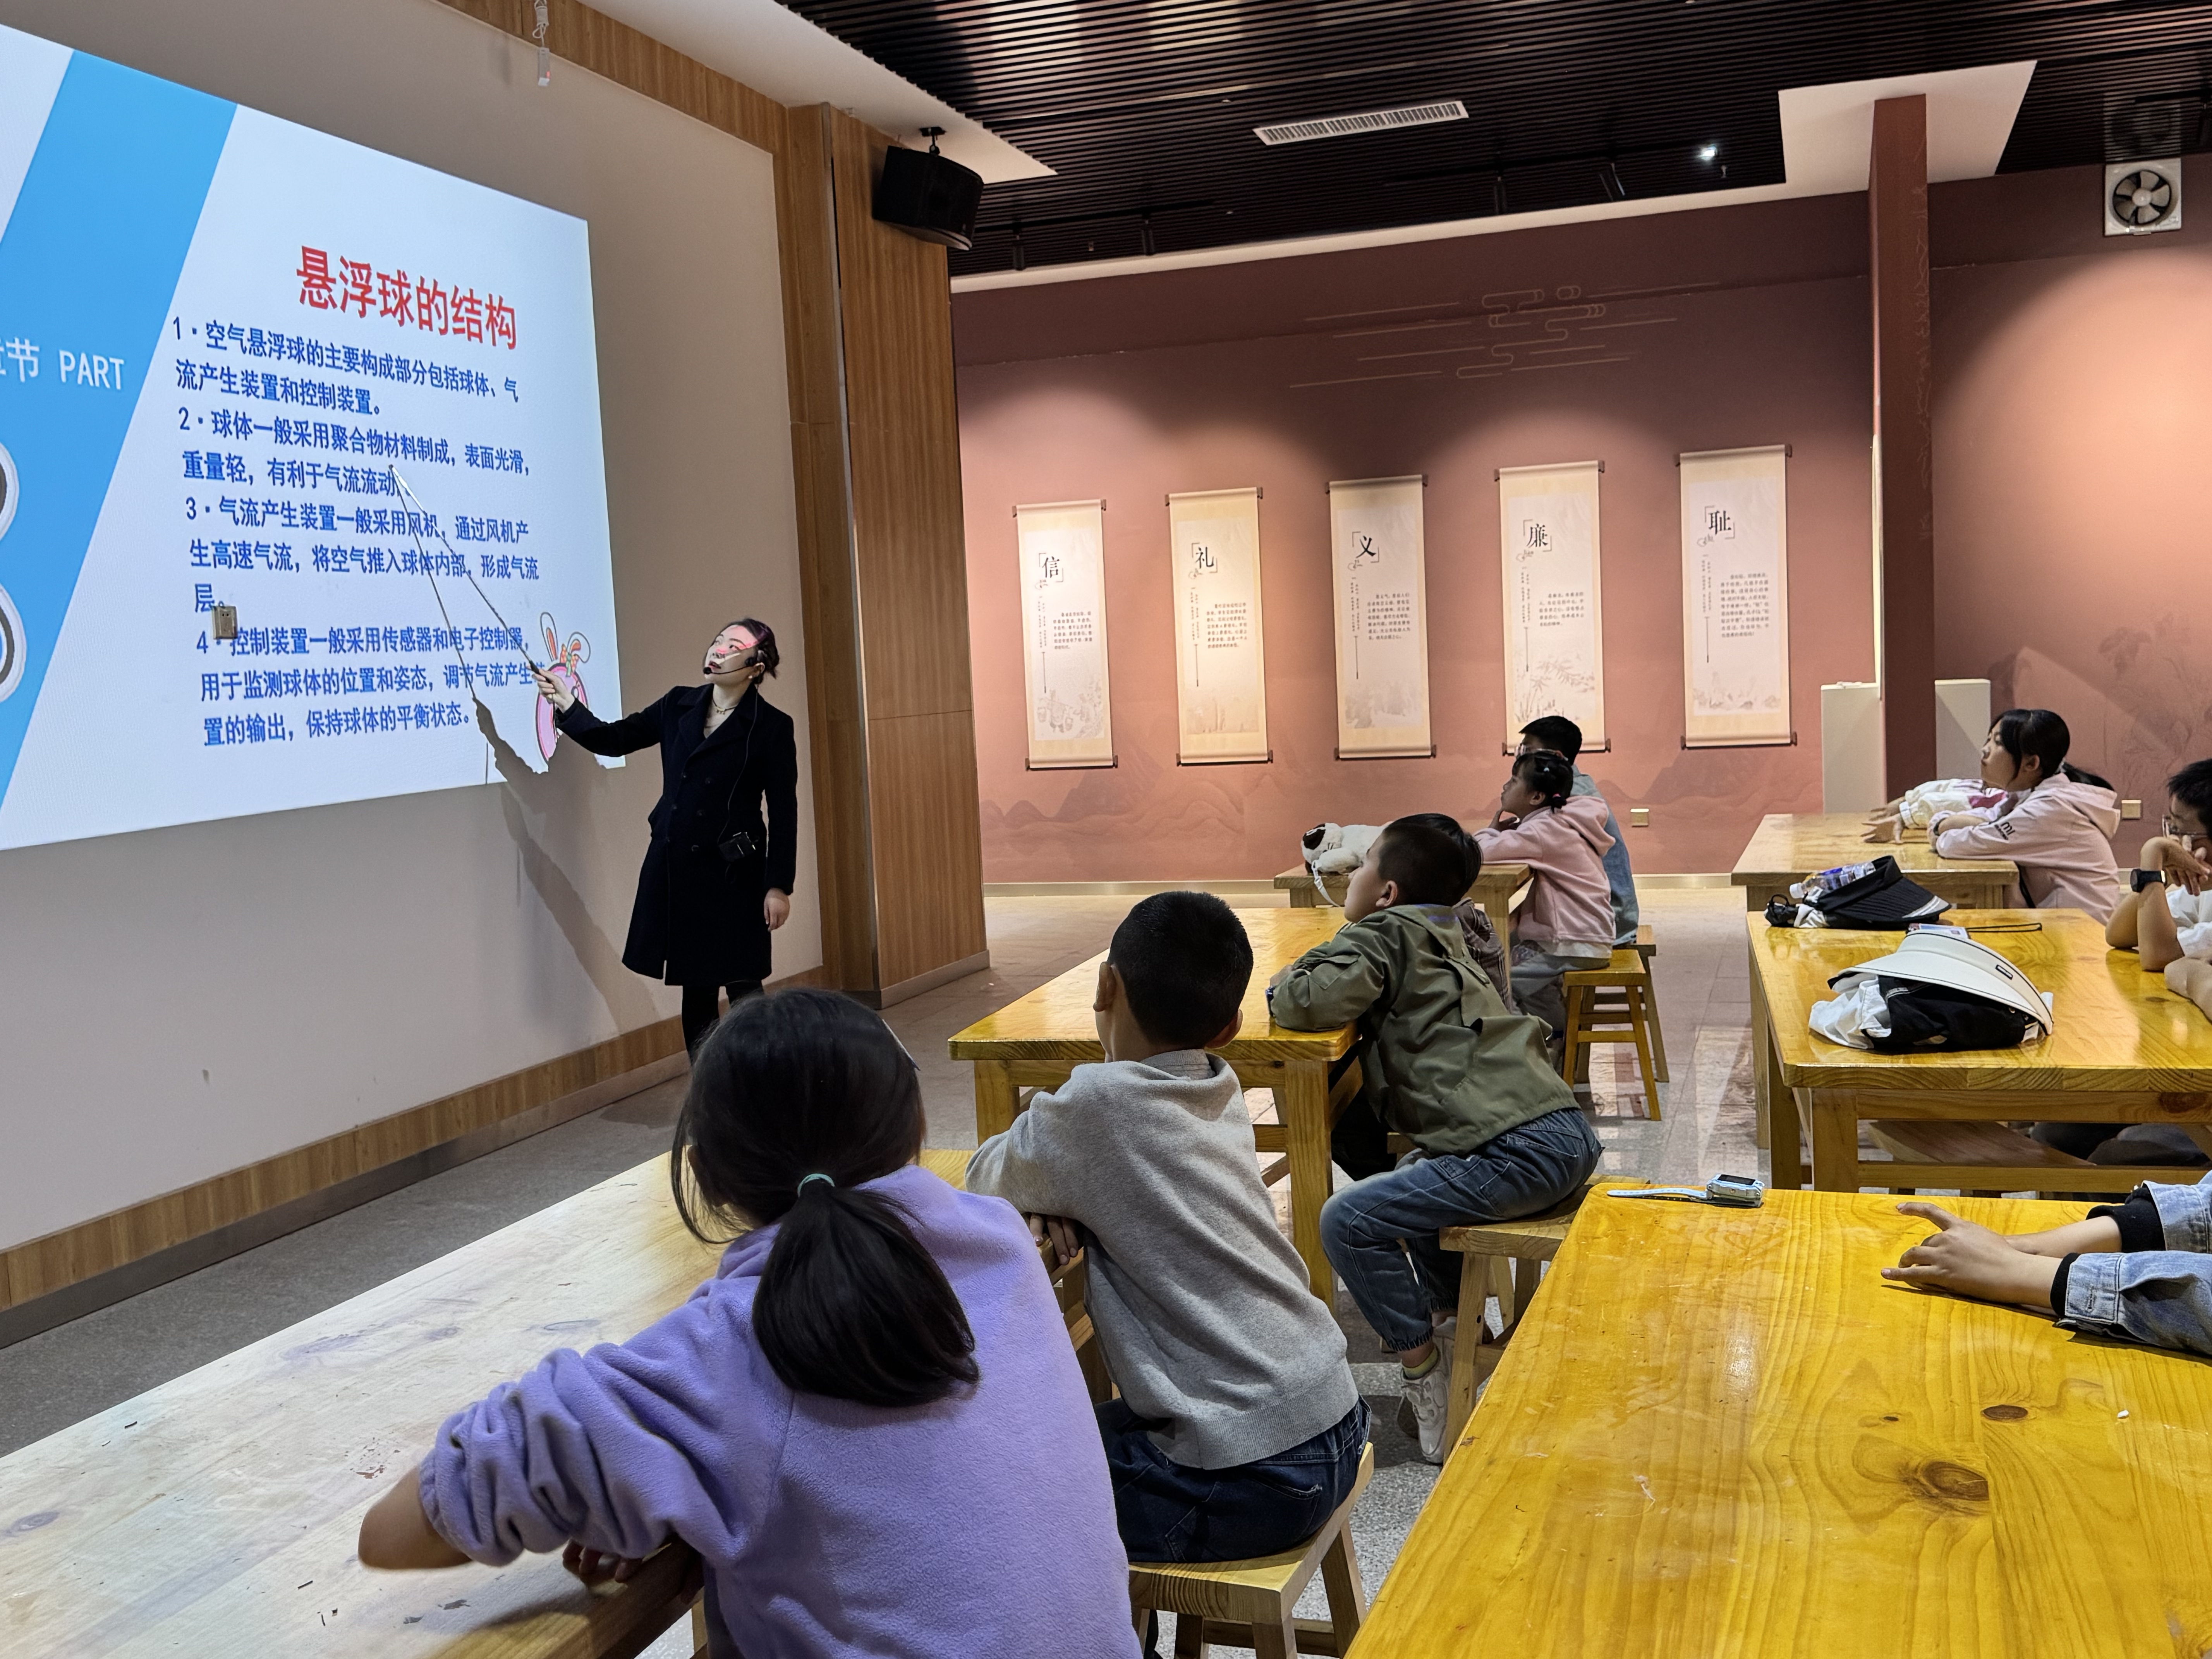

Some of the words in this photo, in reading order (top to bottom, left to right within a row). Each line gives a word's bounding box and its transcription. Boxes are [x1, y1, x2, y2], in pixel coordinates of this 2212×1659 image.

[297, 245, 517, 351] 悬浮球的结构
[0, 337, 40, 383] 节
[59, 349, 124, 390] PART
[176, 359, 380, 415] 流产生装置和控制装置。
[1709, 510, 1732, 535] 耻
[1355, 535, 1377, 559] 义
[1527, 524, 1548, 548] 廉
[1042, 556, 1060, 579] 信
[1195, 546, 1215, 569] 礼
[201, 662, 544, 702] 用于监测球体的位置和姿态，调节气流产生
